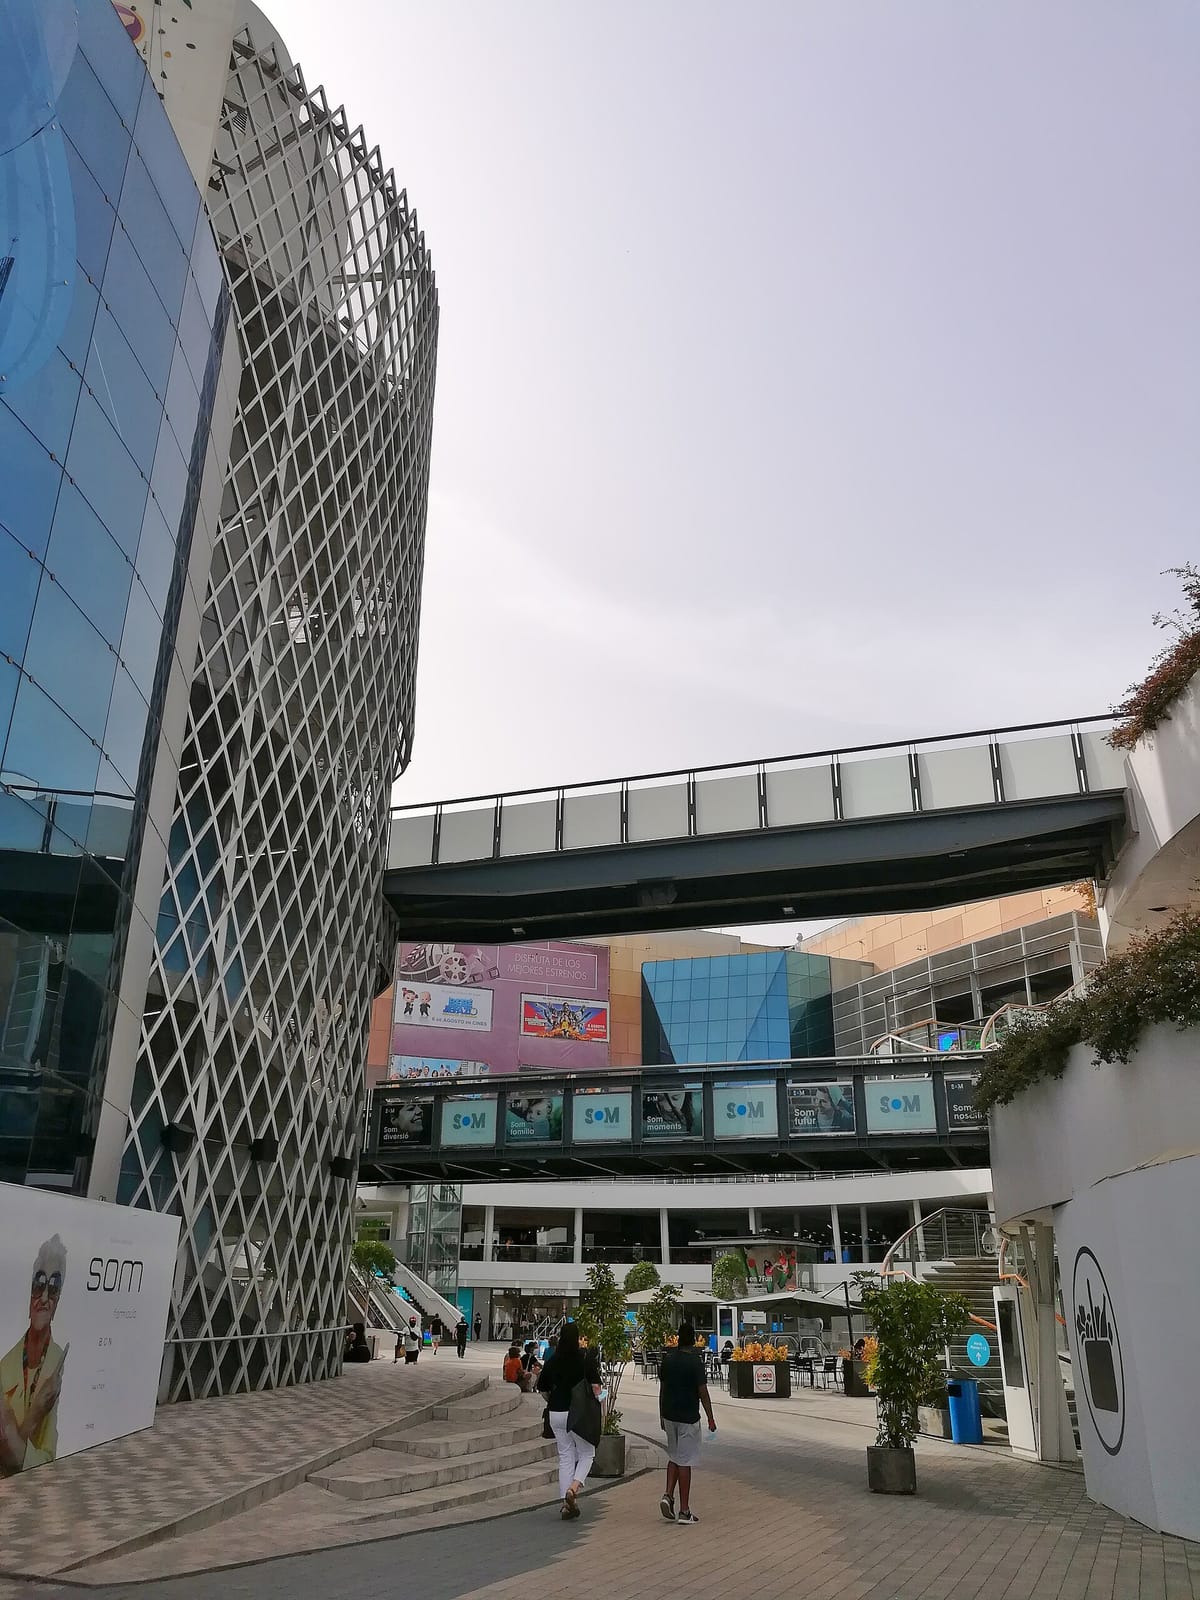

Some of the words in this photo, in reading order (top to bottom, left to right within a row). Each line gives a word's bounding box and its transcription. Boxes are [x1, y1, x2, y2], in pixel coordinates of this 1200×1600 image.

[514, 952, 551, 966] DISFRUTA
[552, 957, 564, 966] DE
[565, 959, 581, 969] LOS
[507, 964, 544, 976] MEJORES
[545, 967, 587, 980] ESTRENOS
[726, 1101, 764, 1119] SOM
[880, 1095, 920, 1113] SOM
[952, 1104, 972, 1112] Som
[584, 1106, 620, 1124] SOM
[646, 1115, 664, 1123] Som
[794, 1109, 815, 1117] Som
[452, 1112, 486, 1130] SOM
[647, 1122, 682, 1131] moments
[794, 1117, 816, 1125] futur
[383, 1132, 409, 1140] diversió
